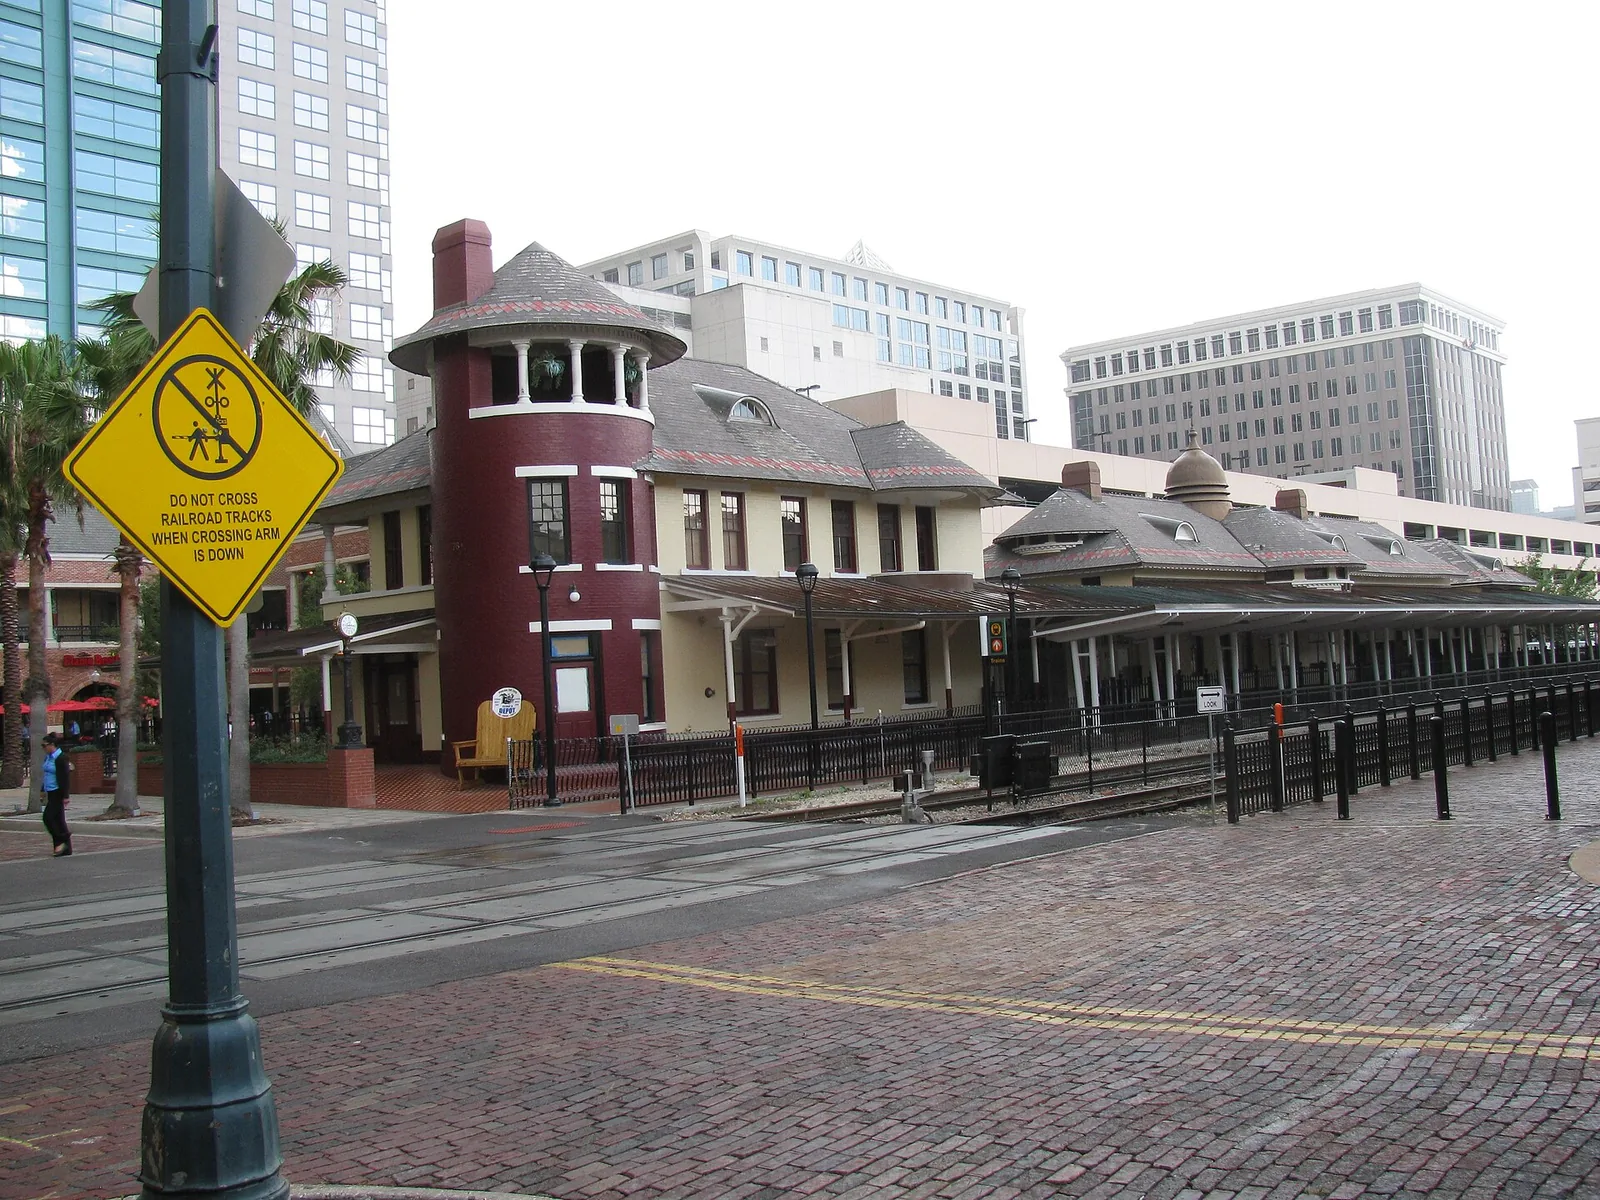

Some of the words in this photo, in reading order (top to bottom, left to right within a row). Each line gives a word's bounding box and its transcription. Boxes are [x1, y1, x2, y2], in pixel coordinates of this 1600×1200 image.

[170, 494, 187, 507] DO
[191, 493, 214, 506] NOT
[218, 492, 258, 505] CROSS
[161, 511, 222, 526] RAILROAD
[225, 509, 272, 523] TRACKS
[152, 531, 188, 545] WHEN
[192, 529, 252, 543] CROSSING
[255, 527, 280, 540] ARM
[194, 549, 204, 562] IS
[208, 547, 244, 561] DOWN
[498, 707, 515, 715] DEPOT
